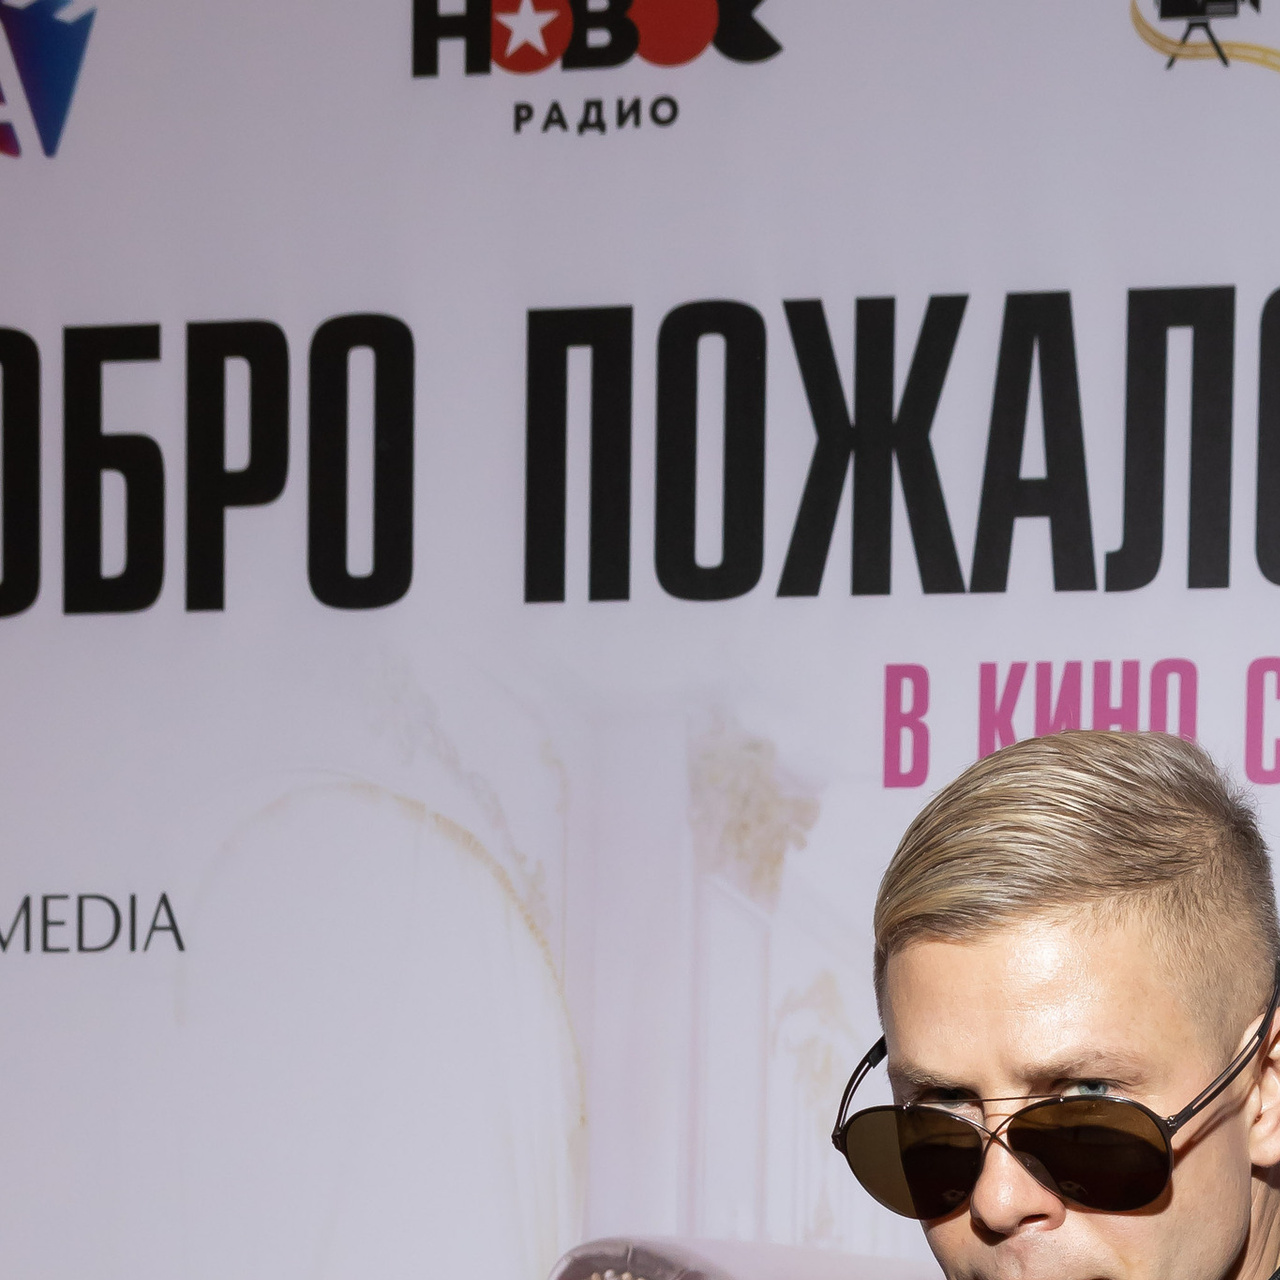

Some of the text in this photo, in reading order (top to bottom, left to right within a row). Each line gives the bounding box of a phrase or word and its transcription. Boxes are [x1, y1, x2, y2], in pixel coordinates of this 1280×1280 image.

[513, 95, 679, 136] РАДИО
[883, 663, 930, 788] В
[978, 657, 1199, 760] КИНО
